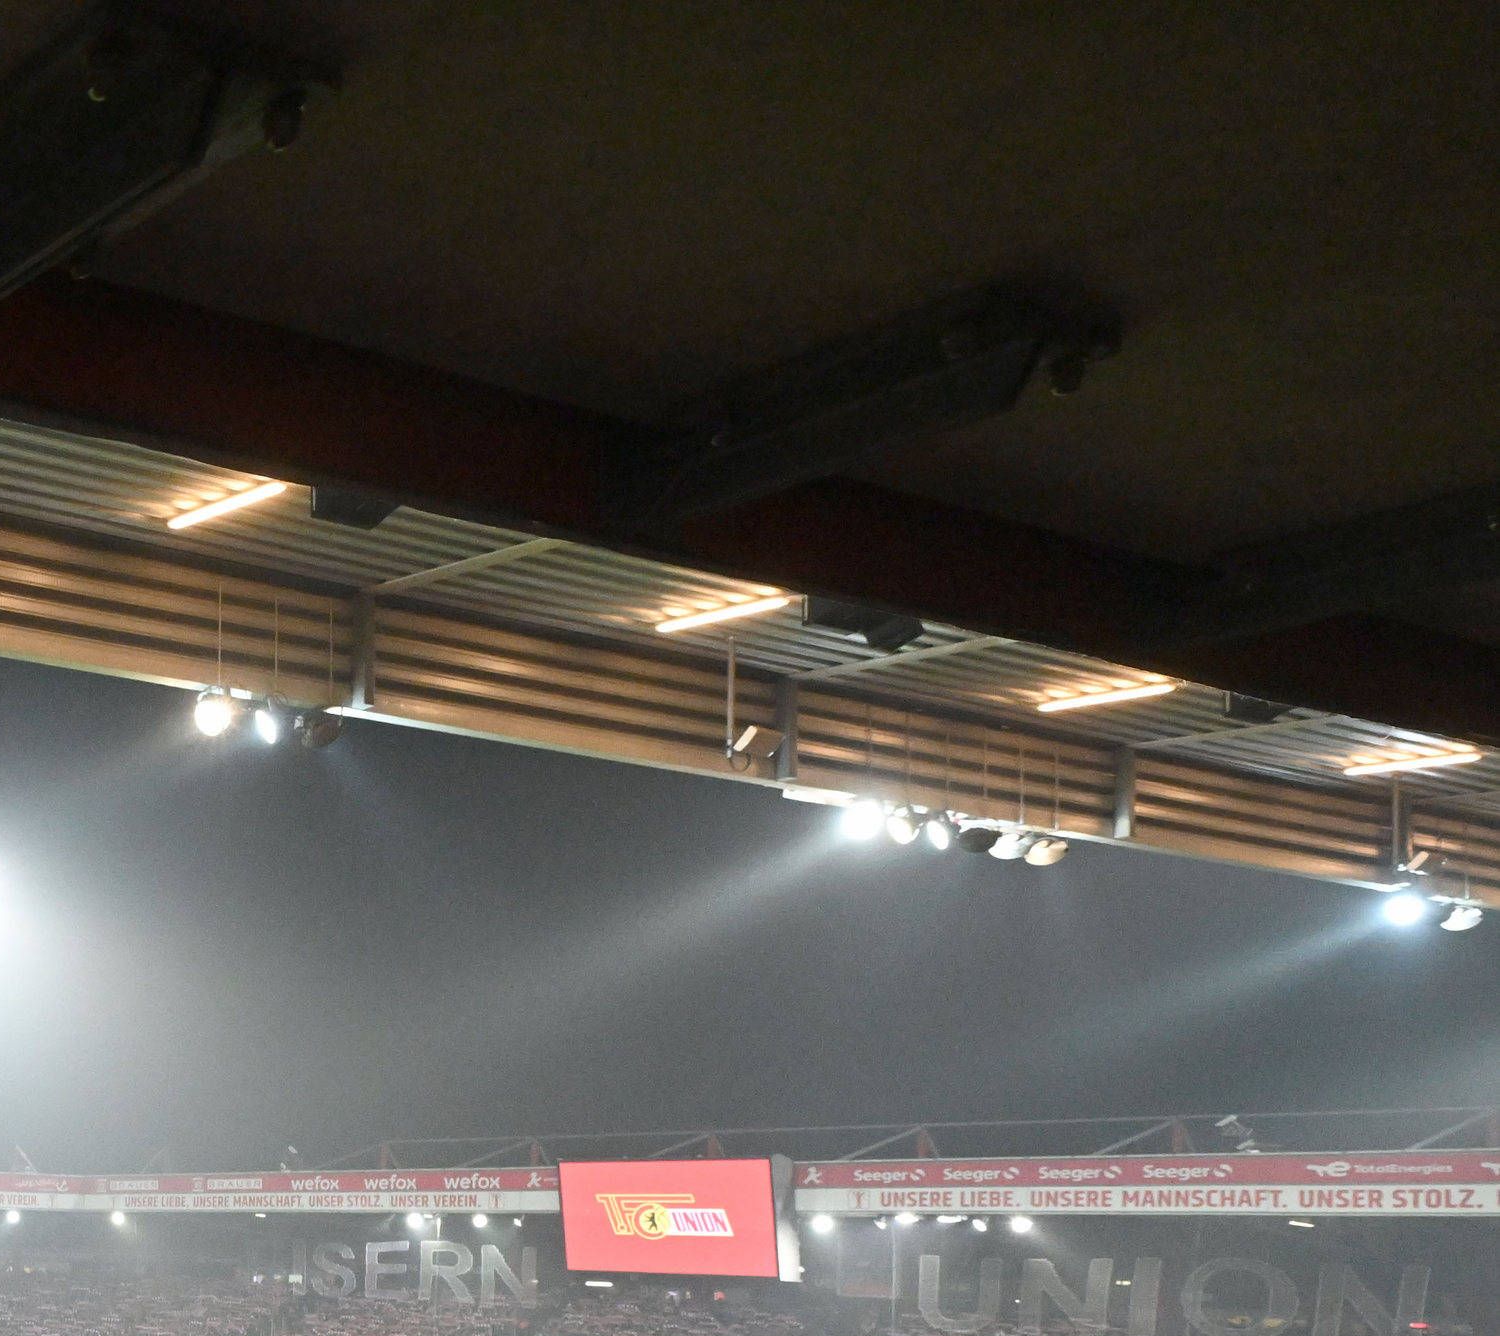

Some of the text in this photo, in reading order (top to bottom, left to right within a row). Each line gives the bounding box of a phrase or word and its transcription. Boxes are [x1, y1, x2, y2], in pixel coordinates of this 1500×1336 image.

[853, 1168, 907, 1185] Seeger
[943, 1167, 1001, 1183] Seeger
[1039, 1166, 1102, 1181] Seeger
[1142, 1165, 1210, 1180] Seeger
[291, 1176, 339, 1192] wefox
[364, 1174, 417, 1191] wefox
[443, 1172, 500, 1190] wefox
[309, 1194, 344, 1208] UNSER
[390, 1194, 429, 1208] UNSER
[434, 1194, 481, 1208] VEREIN.
[880, 1188, 1484, 1209] UNSERE LIEBE. UNSERE MANNSCHAFT. UNSER STOLZ.
[672, 1211, 730, 1233] UNION
